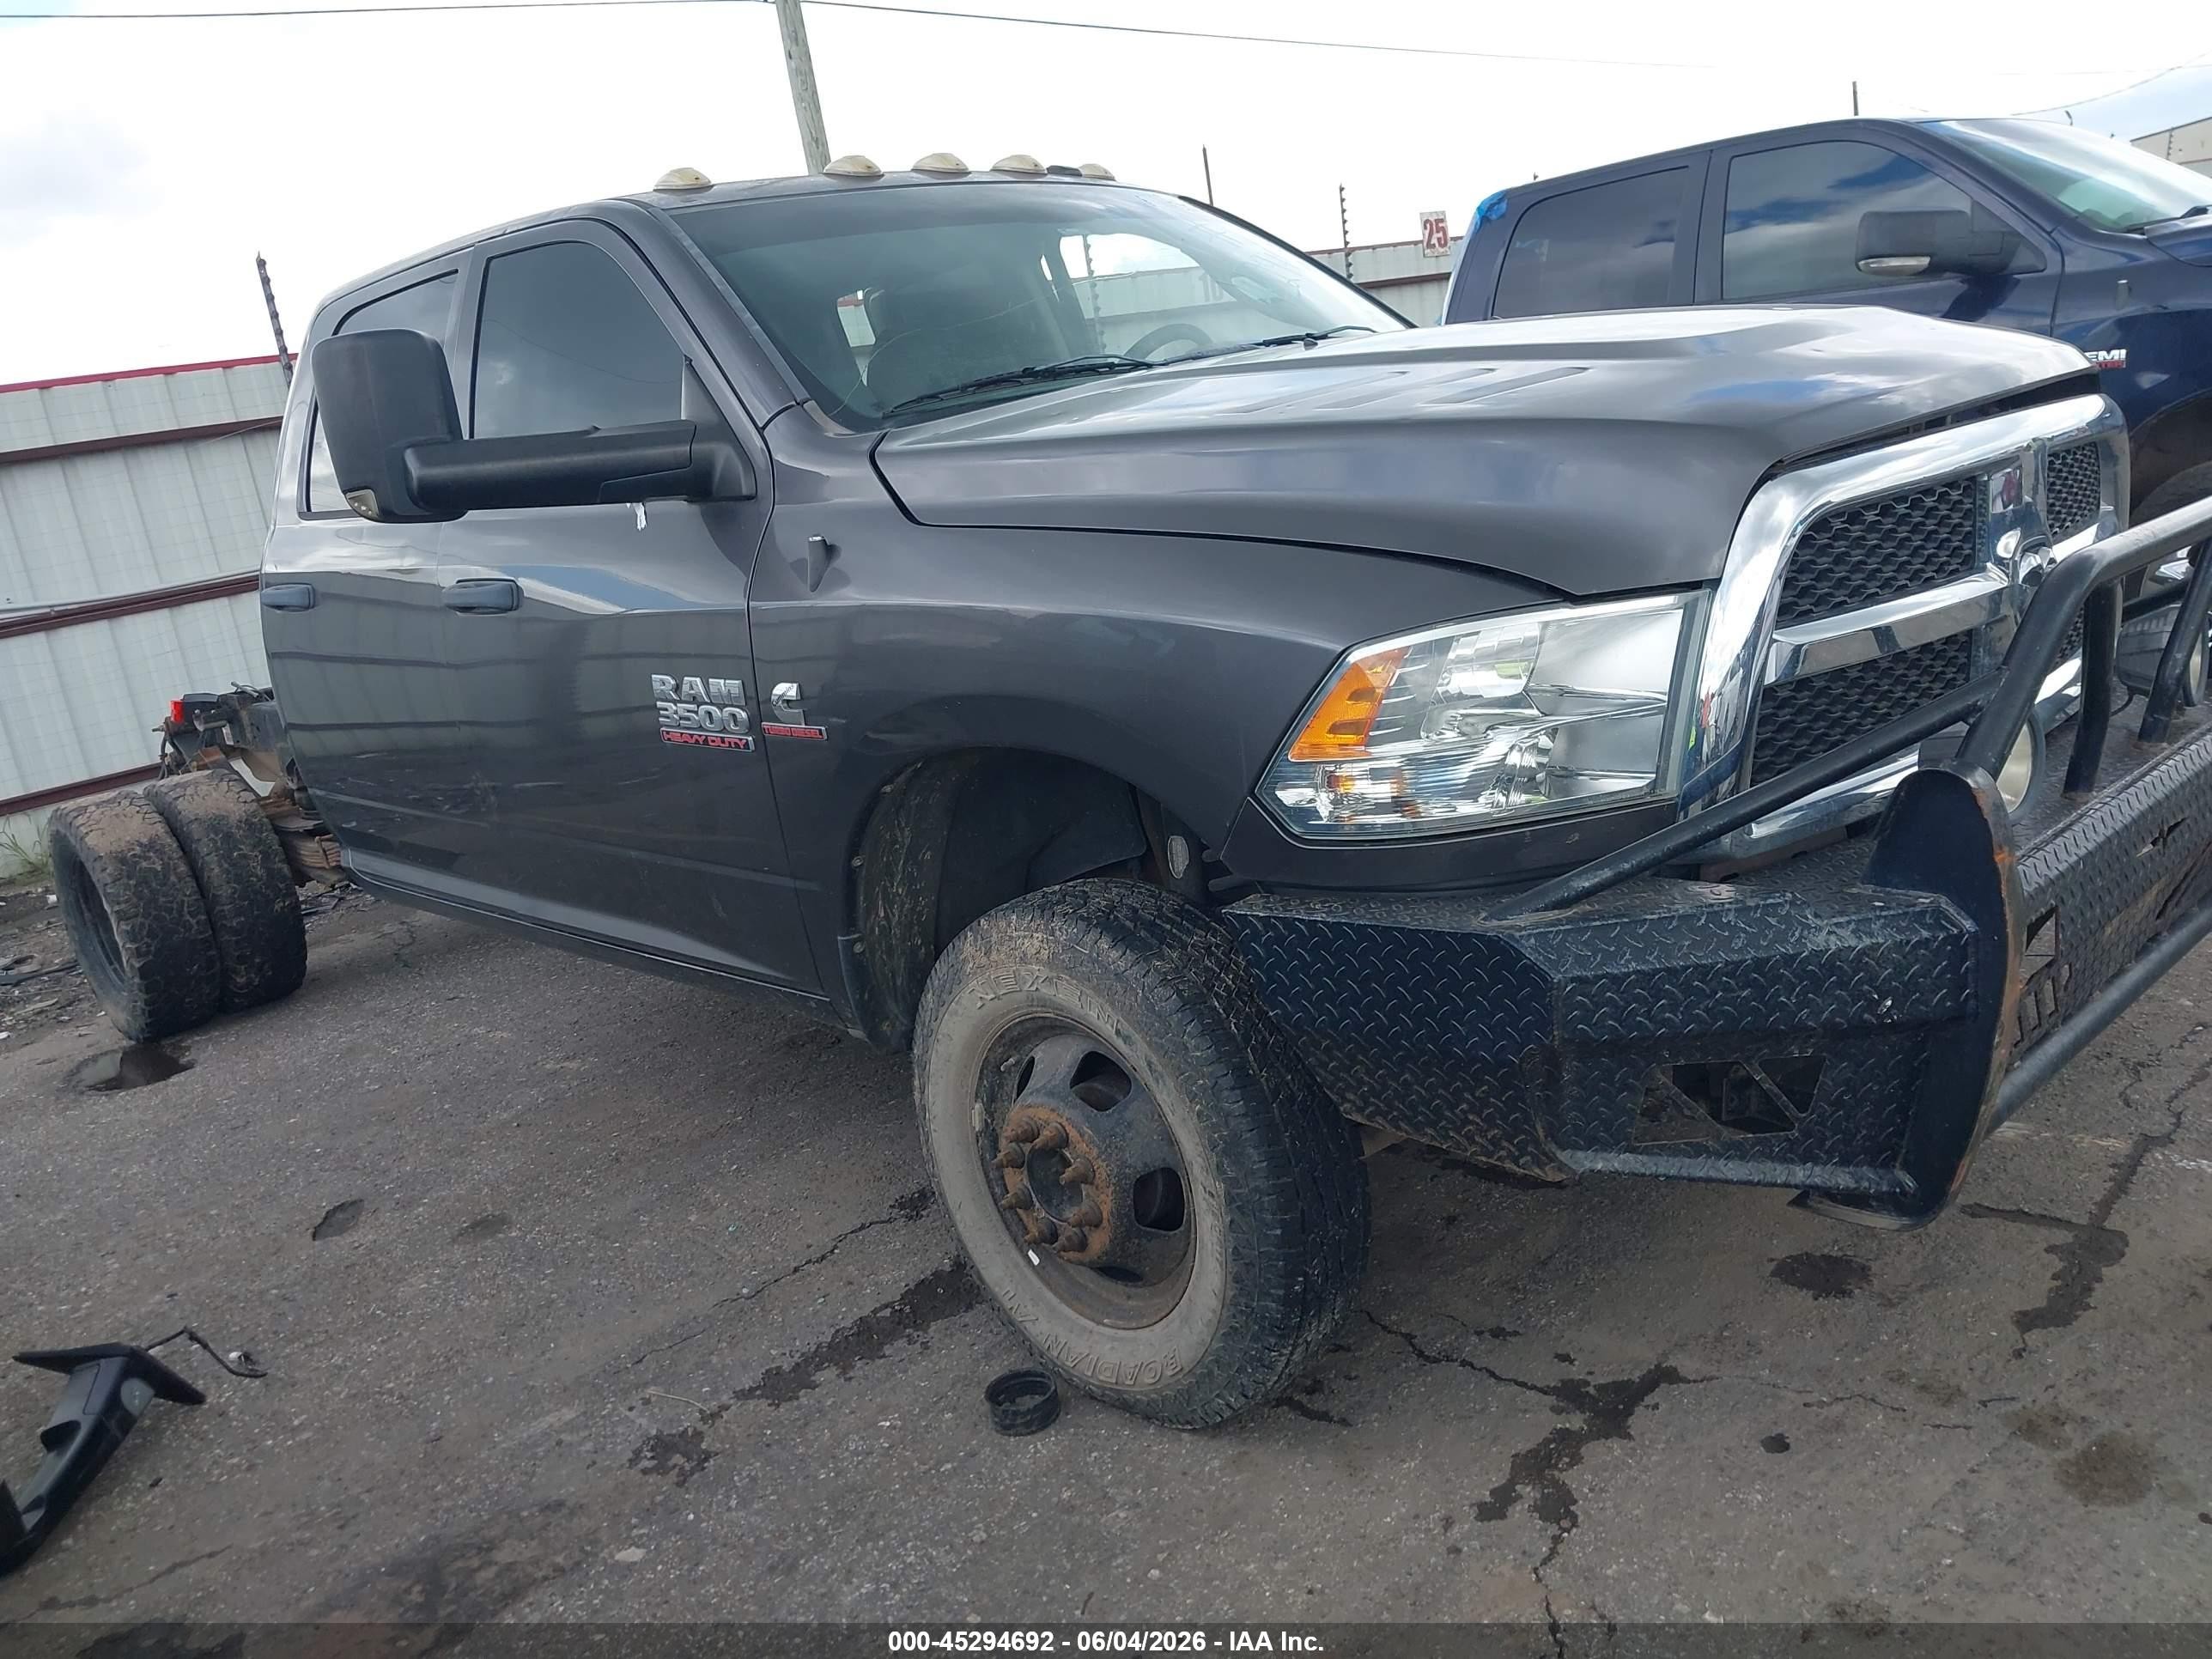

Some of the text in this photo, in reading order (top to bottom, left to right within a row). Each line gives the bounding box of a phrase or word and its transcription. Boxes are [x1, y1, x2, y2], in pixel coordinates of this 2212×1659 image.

[1423, 218, 1449, 249] 25
[2084, 349, 2127, 362] EMI
[651, 674, 746, 706] RAM
[656, 702, 751, 734] 3500
[663, 731, 748, 750] HEAVY DUTY
[1042, 1332, 1183, 1386] ROADIAN
